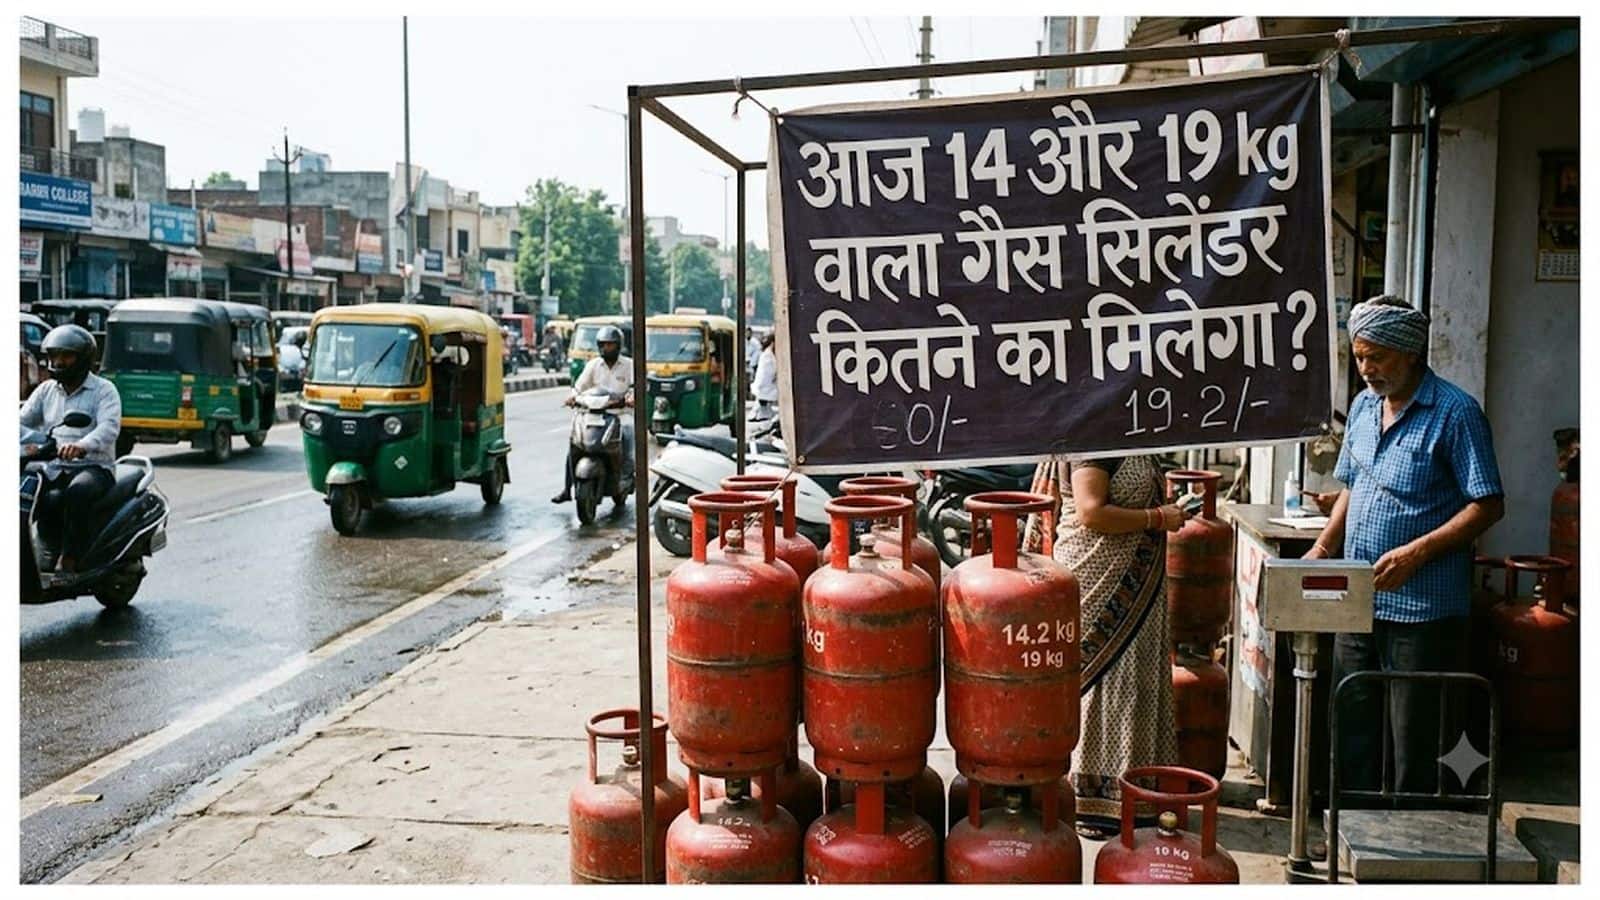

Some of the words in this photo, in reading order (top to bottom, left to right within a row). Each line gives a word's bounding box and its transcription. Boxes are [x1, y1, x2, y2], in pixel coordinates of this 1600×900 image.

[797, 136, 930, 208] आज
[946, 128, 1015, 199] 14
[1027, 99, 1140, 195] और
[1158, 109, 1222, 183] 19
[1236, 111, 1299, 191] kg
[809, 233, 943, 303] वाला
[956, 204, 1067, 294] गैस
[1076, 193, 1288, 288] सिलेंडर
[810, 303, 980, 396] कितने
[992, 320, 1072, 386] का
[1002, 624, 1050, 645] 14.2
[1056, 620, 1075, 643] kg
[1021, 651, 1041, 668] 19
[1046, 650, 1063, 668] kg
[1154, 846, 1170, 856] 10
